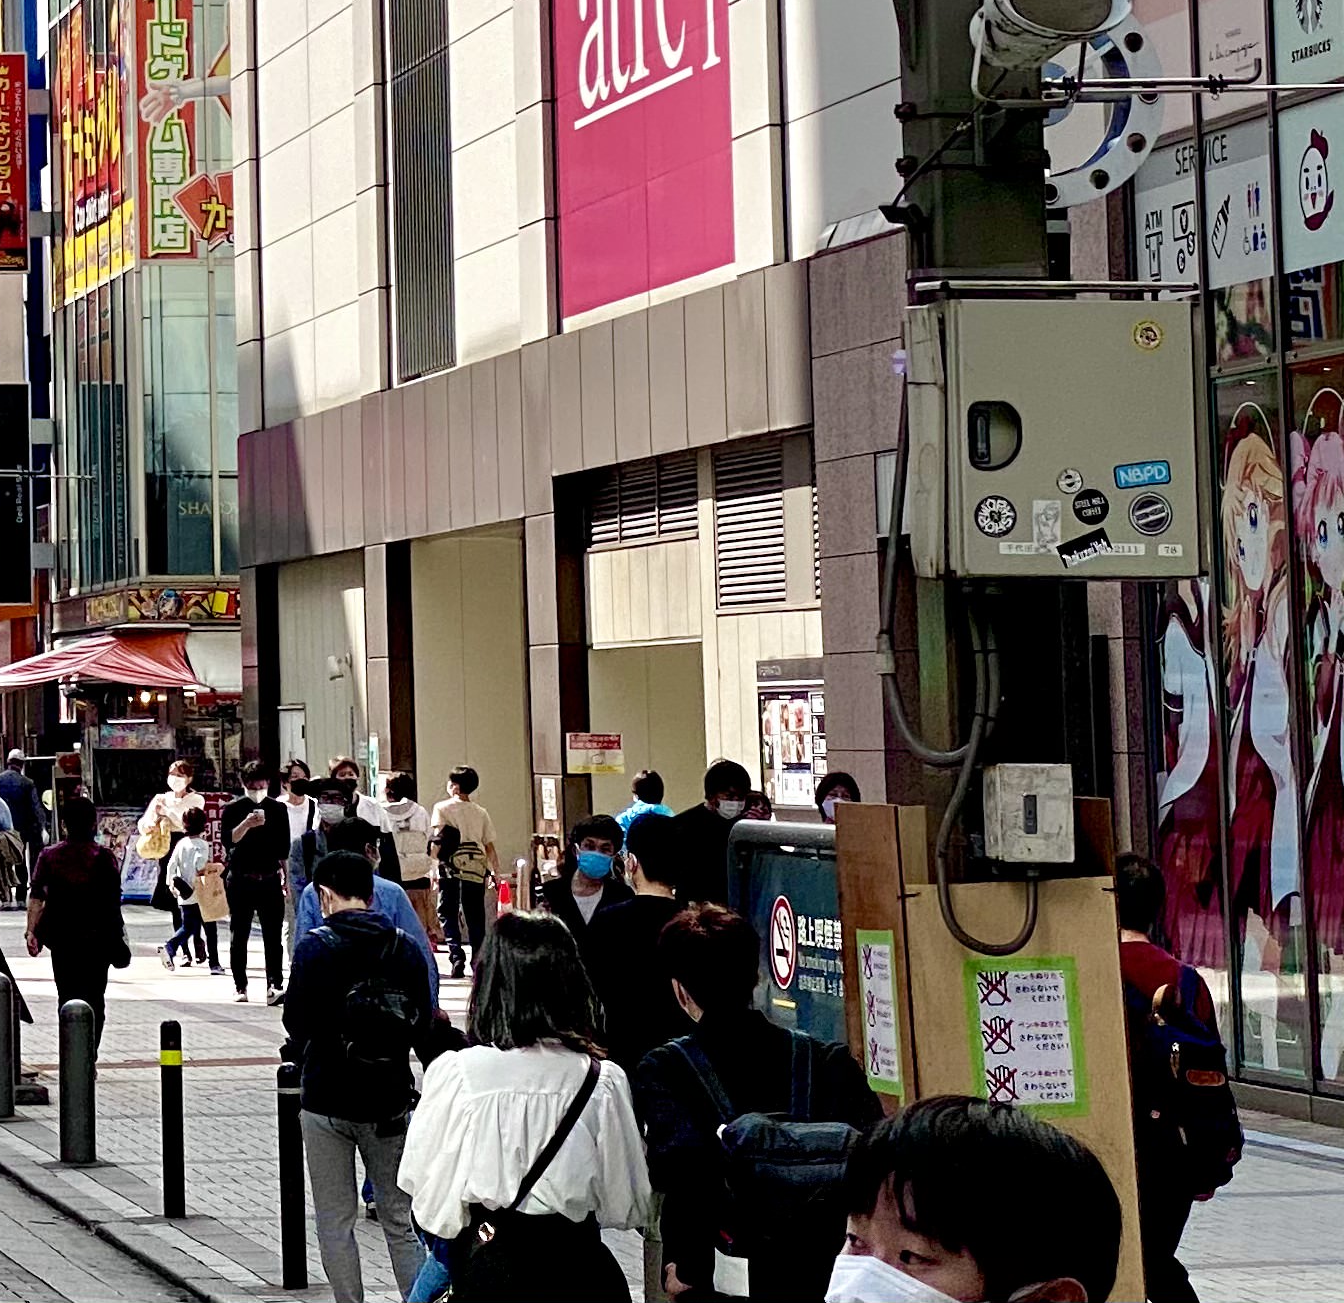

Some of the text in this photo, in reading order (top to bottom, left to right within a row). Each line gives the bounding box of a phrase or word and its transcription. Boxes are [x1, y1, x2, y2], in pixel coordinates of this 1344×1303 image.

[1290, 40, 1333, 65] STARBUCKS
[1144, 209, 1163, 232] ATM
[1118, 465, 1168, 484] NBPD
